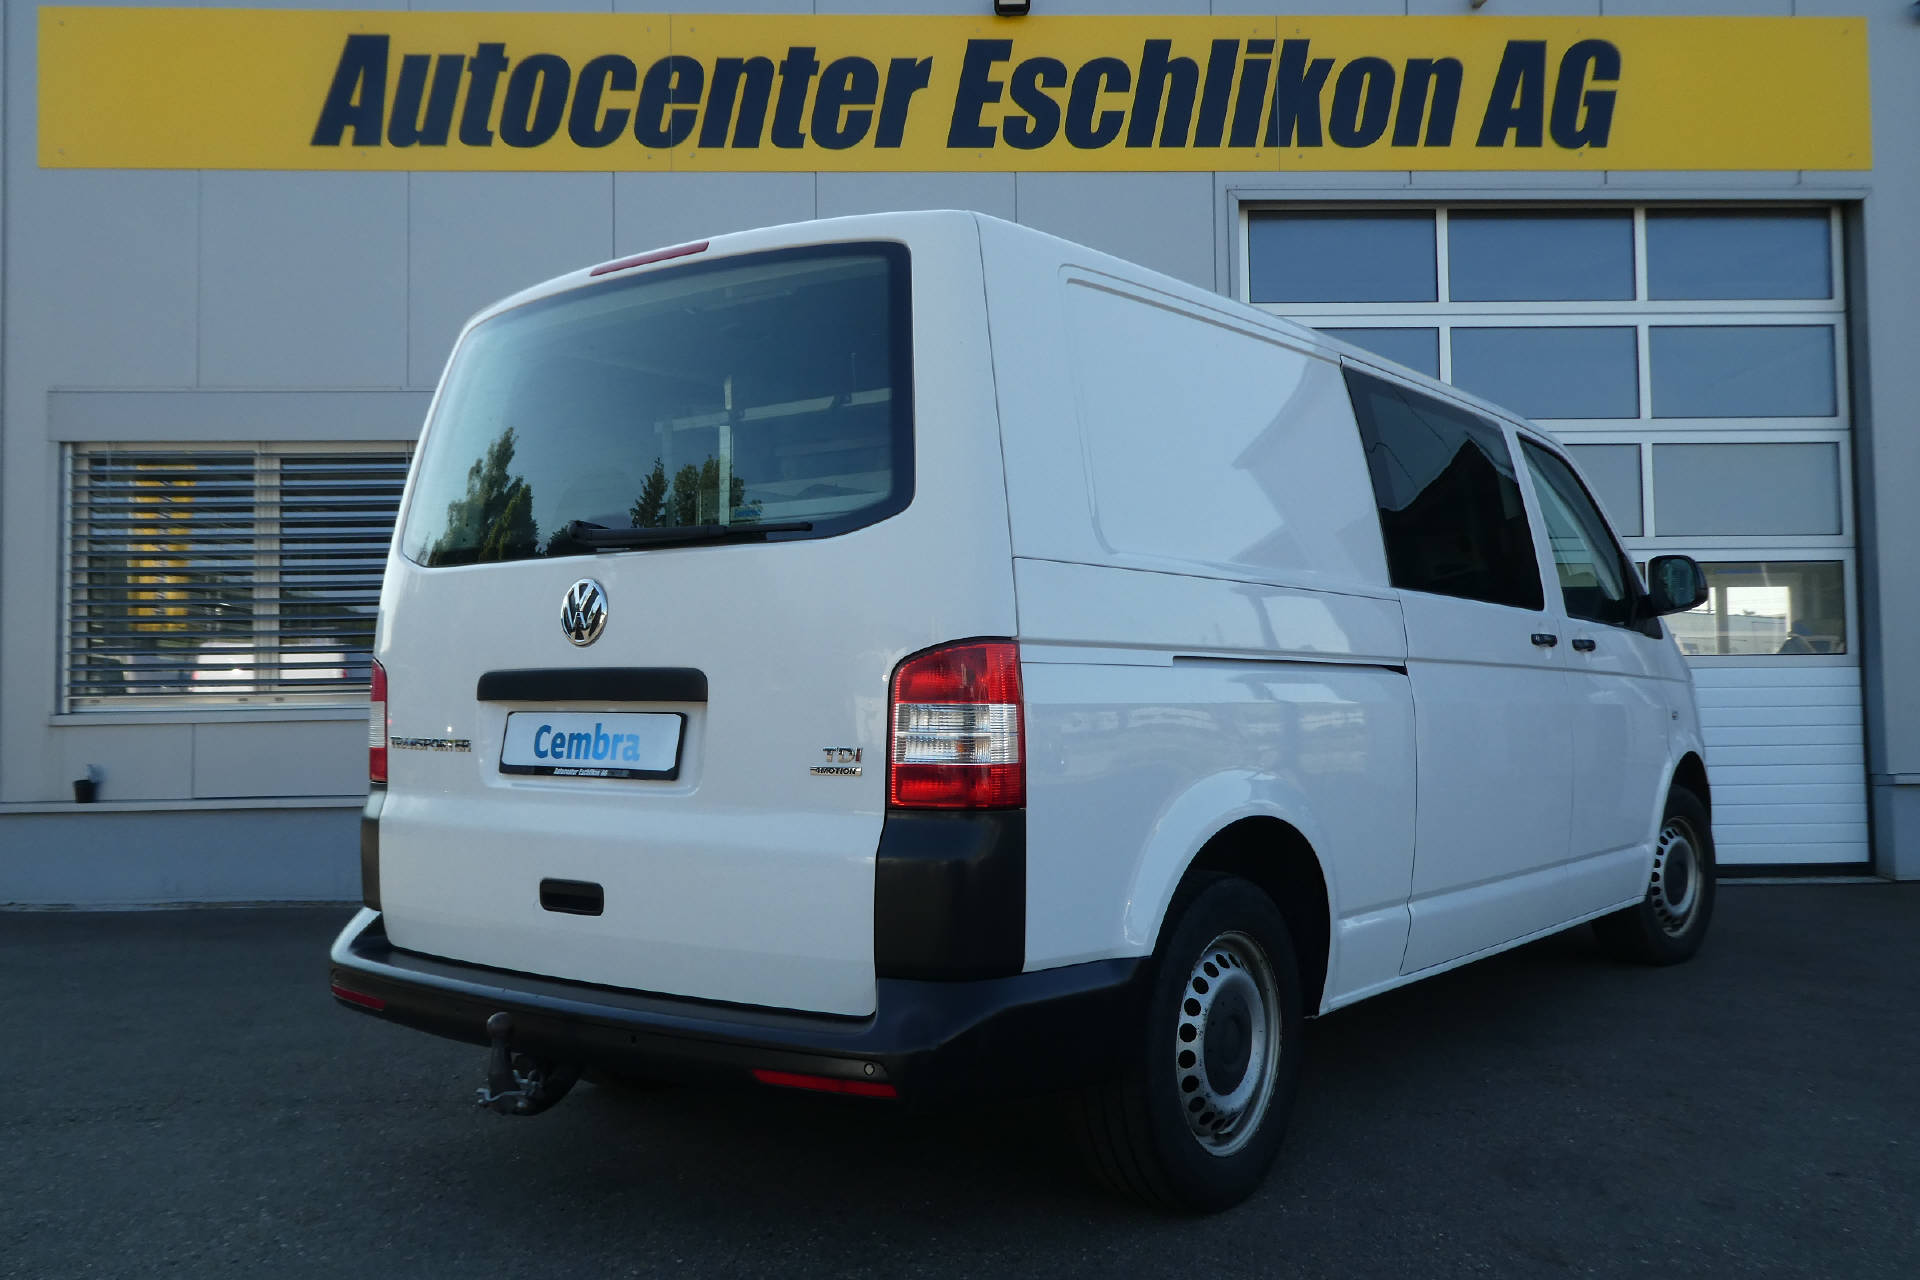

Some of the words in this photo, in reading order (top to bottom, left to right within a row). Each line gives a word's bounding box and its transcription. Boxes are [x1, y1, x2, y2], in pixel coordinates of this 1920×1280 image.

[311, 33, 932, 148] Autocenter
[947, 38, 1463, 149] Eschlikon
[1476, 38, 1622, 149] AG
[535, 723, 640, 761] Cembra
[822, 746, 863, 763] TDI
[815, 767, 857, 775] 4MOTION
